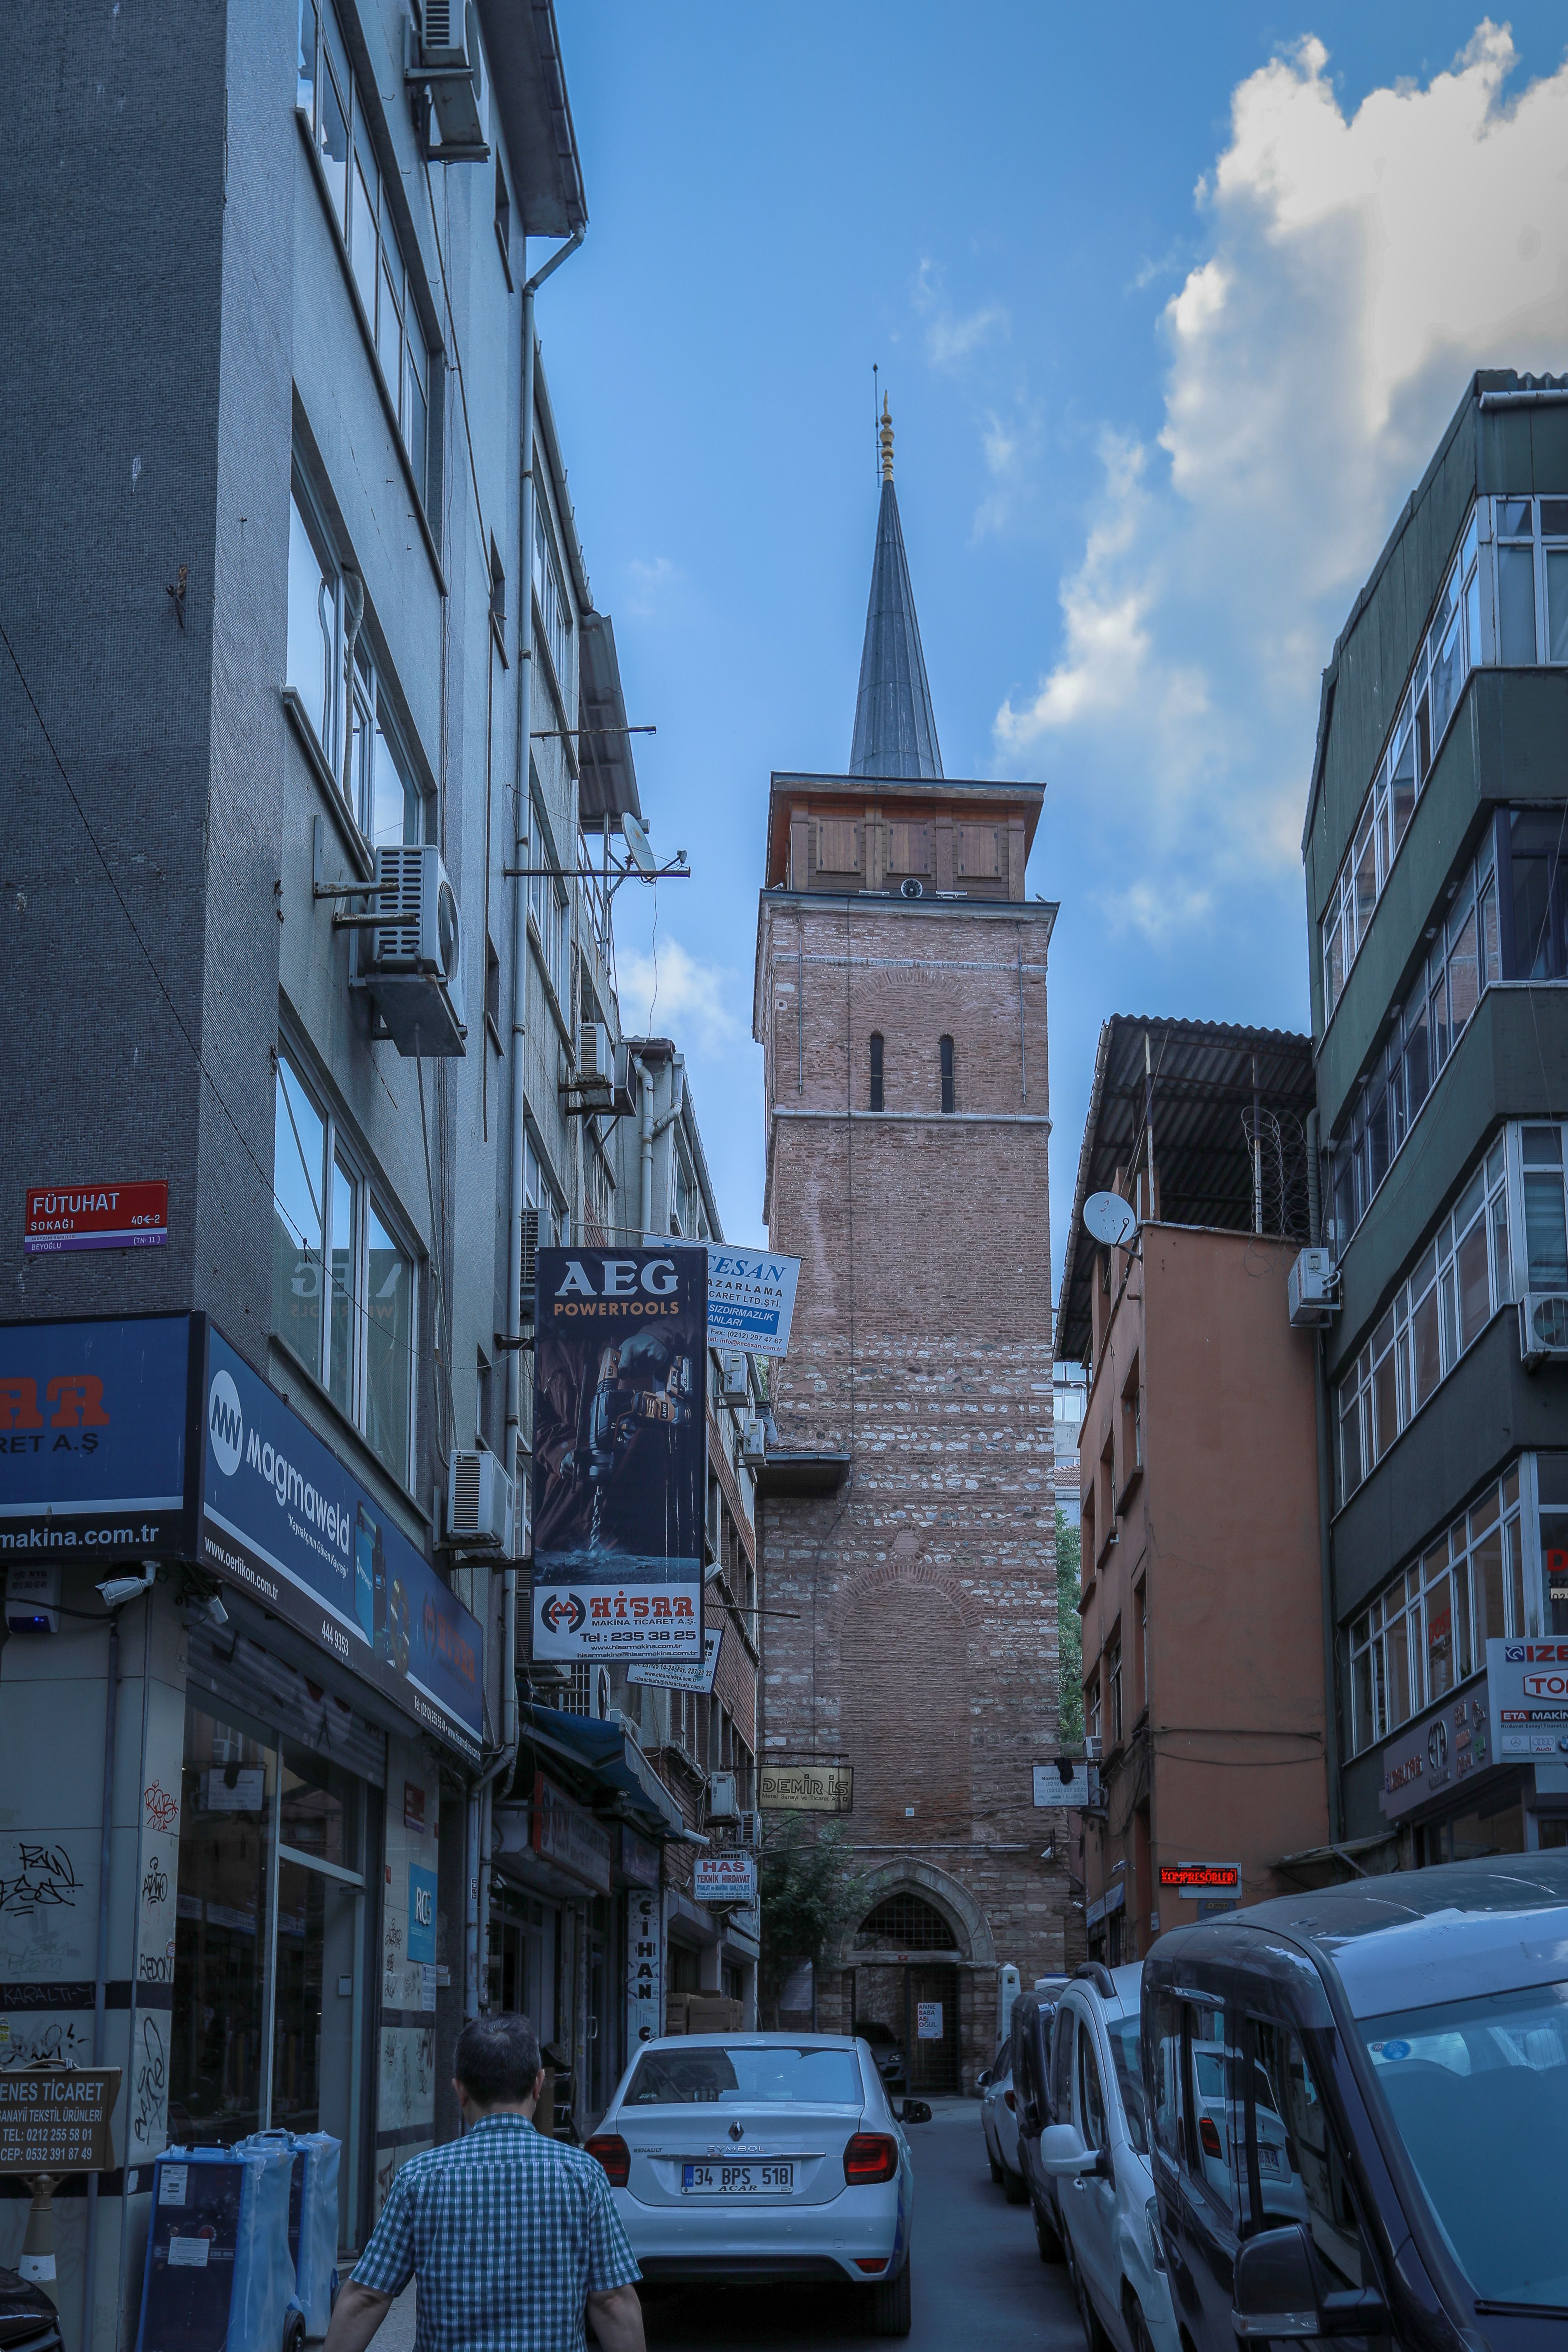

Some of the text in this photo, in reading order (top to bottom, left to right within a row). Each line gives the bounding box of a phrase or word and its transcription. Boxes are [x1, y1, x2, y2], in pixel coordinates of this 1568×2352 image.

[33, 1193, 120, 1215] FÜTUHAT
[31, 1219, 74, 1231] SOKAĞI
[31, 1242, 61, 1250] BEYOĞLU
[554, 1259, 678, 1296] AEG
[709, 1290, 741, 1301] CARET
[554, 1301, 679, 1316] POWERTOOLS
[708, 1304, 774, 1321] SIZDIRMAZLIK
[710, 1328, 725, 1336] Fax:
[727, 1330, 748, 1340] (0212)
[720, 1338, 782, 1352] info@kecesan.com.tr
[317, 1541, 331, 1562] Güven
[205, 1536, 278, 1601] www.oerlikon.com.tr
[590, 1590, 695, 1618] HİSAR
[322, 1620, 349, 1656] 444 9353
[611, 1632, 644, 1641] 235
[648, 1631, 670, 1640] 38
[674, 1630, 696, 1640] 25
[634, 1676, 705, 1691] cihancivata@cihancivata.com.tr
[645, 1672, 697, 1682] www.cihancivata.com.tr
[1529, 1677, 1568, 1694] TO
[421, 1701, 431, 1724] (0212)
[442, 1719, 446, 1733] 41
[762, 1774, 823, 1795] DEMİR
[703, 1861, 745, 1873] HAS
[696, 1873, 750, 1883] TEKNİK HIRDAVAT
[1162, 1871, 1234, 1882] KOMPRESÖRLER
[42, 2078, 104, 2101] TİCARET
[29, 2106, 60, 2122] TEKSTİL
[63, 2106, 103, 2122] ÜRÜNLERİ
[3, 2128, 92, 2142] TEL: 0212 255 58 01
[0, 2147, 93, 2161] CEP: 0532 391 87 49
[695, 2167, 713, 2185] 34
[722, 2167, 751, 2185] BPS
[762, 2167, 788, 2185] 518
